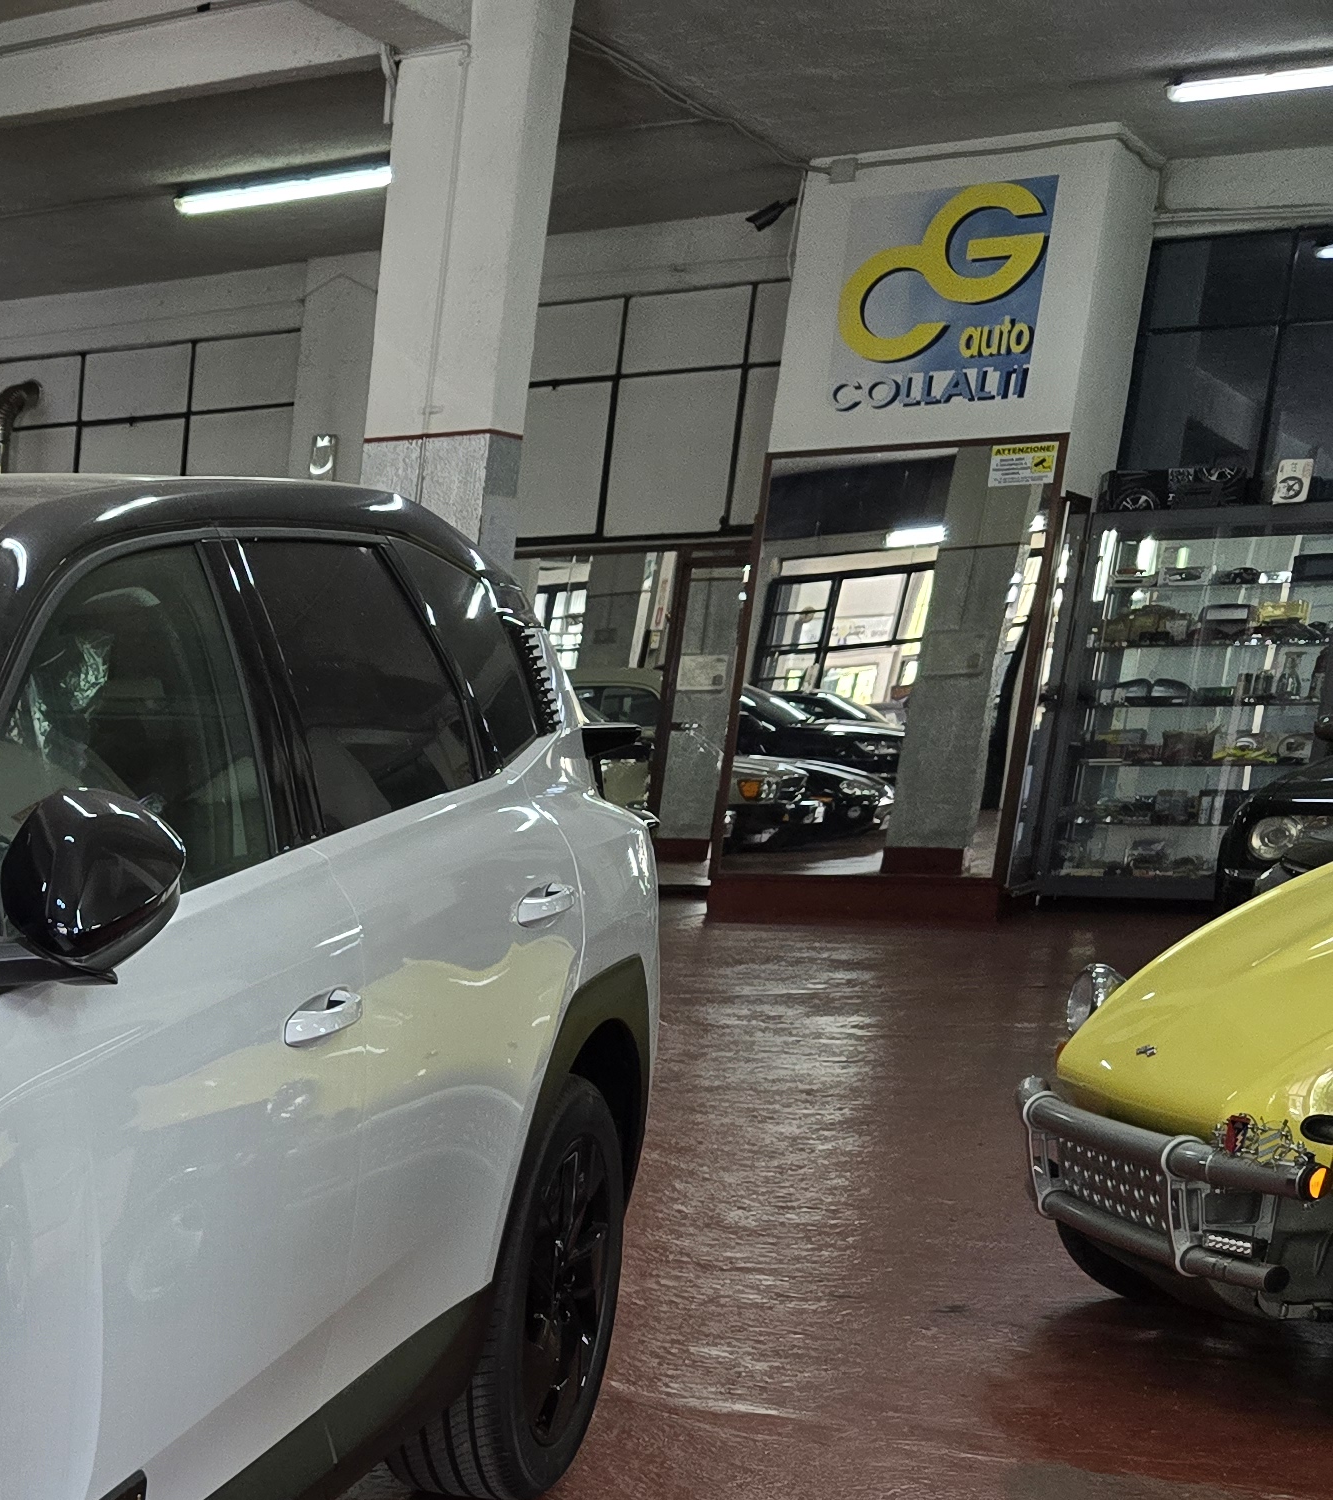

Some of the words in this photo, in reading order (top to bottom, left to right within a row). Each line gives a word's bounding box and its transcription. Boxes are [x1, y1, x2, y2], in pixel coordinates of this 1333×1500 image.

[959, 315, 1032, 358] auto
[831, 364, 1031, 412] COLLALTI
[994, 444, 1055, 456] ATTENZIONE!
